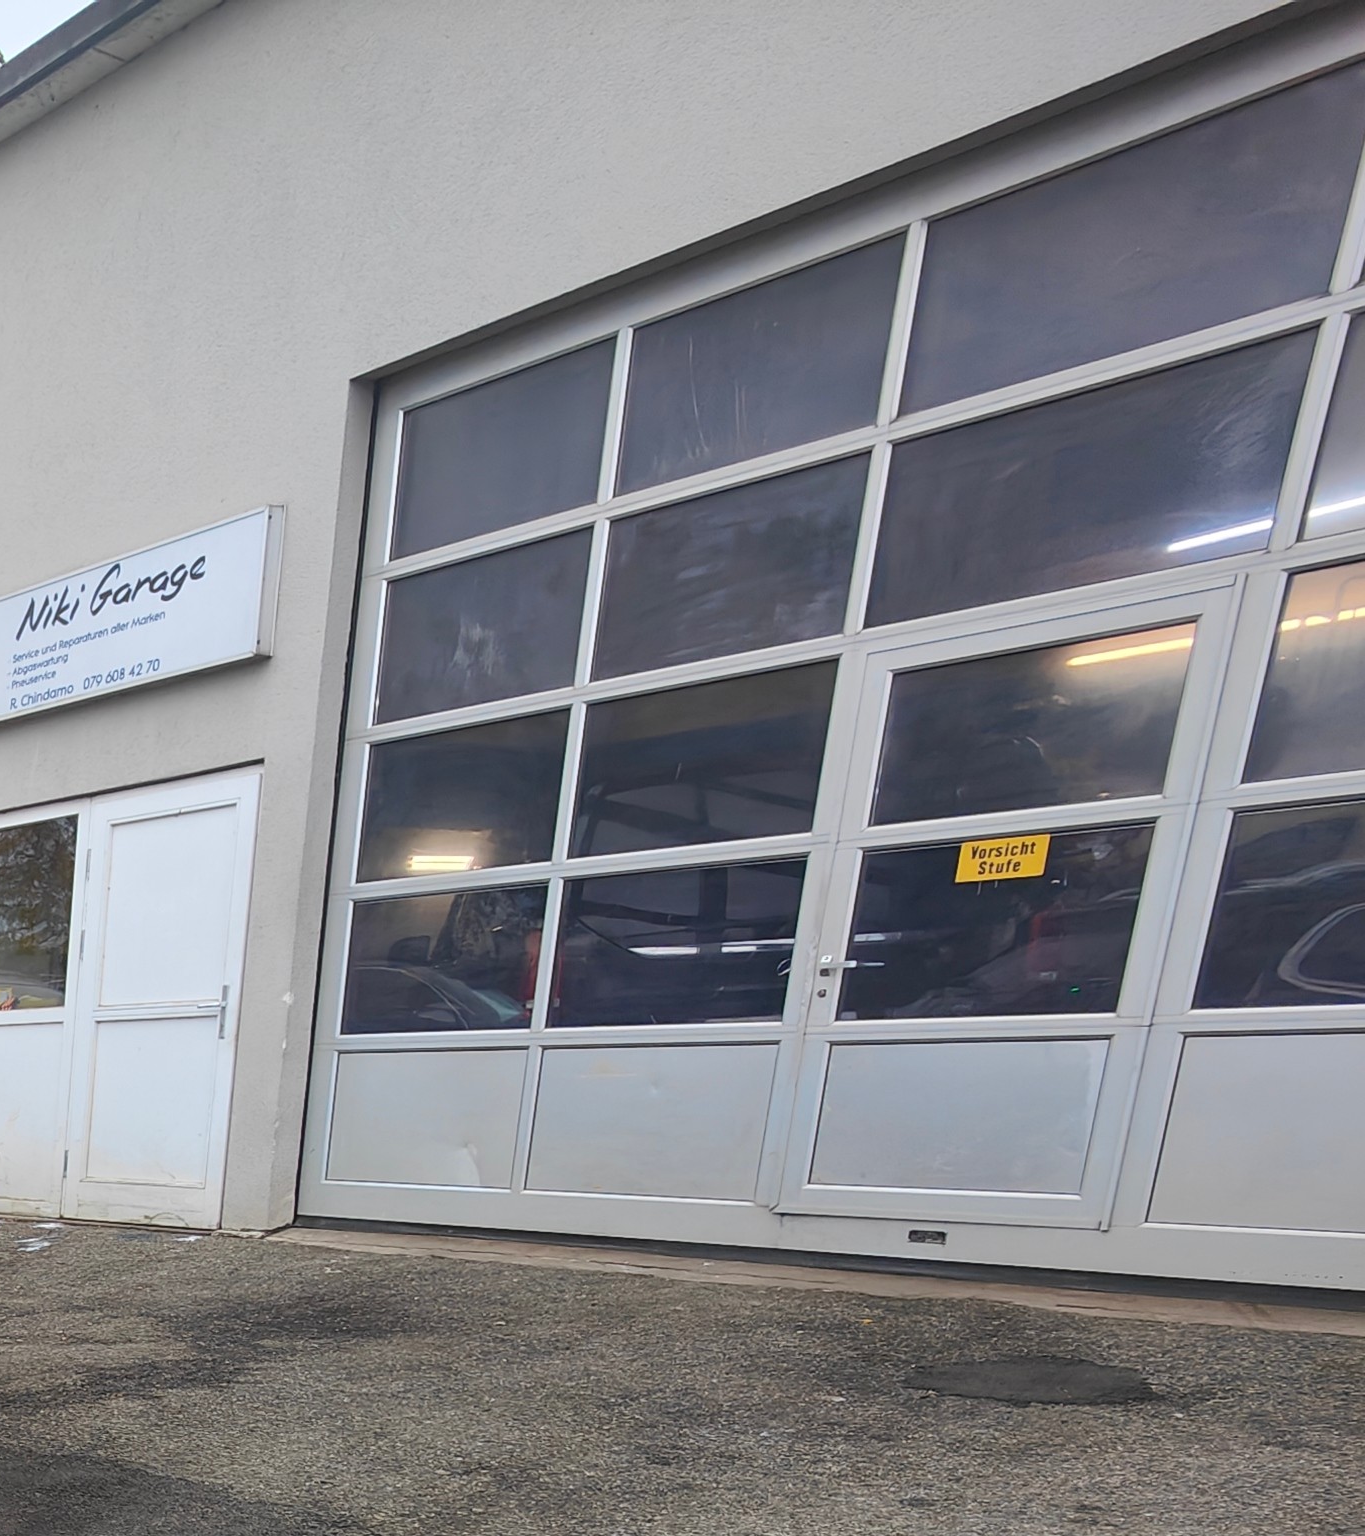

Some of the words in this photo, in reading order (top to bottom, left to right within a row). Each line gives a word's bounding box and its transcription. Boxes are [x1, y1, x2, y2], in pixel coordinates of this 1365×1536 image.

[15, 583, 85, 641] Niki
[90, 556, 206, 617] Garage
[13, 649, 40, 664] Service
[41, 643, 57, 656] und
[58, 628, 109, 652] Reparaturen
[111, 622, 130, 636] aller
[131, 611, 166, 629] Marken
[12, 653, 69, 677] Abgaswartung
[11, 670, 57, 690] Pneuservice
[21, 684, 74, 707] Chindamo
[83, 674, 104, 690] 079
[105, 668, 126, 684] 608
[128, 662, 143, 677] 42
[145, 658, 161, 673] 70
[971, 841, 1037, 860] Vorsicht
[978, 858, 1021, 875] Stufe
